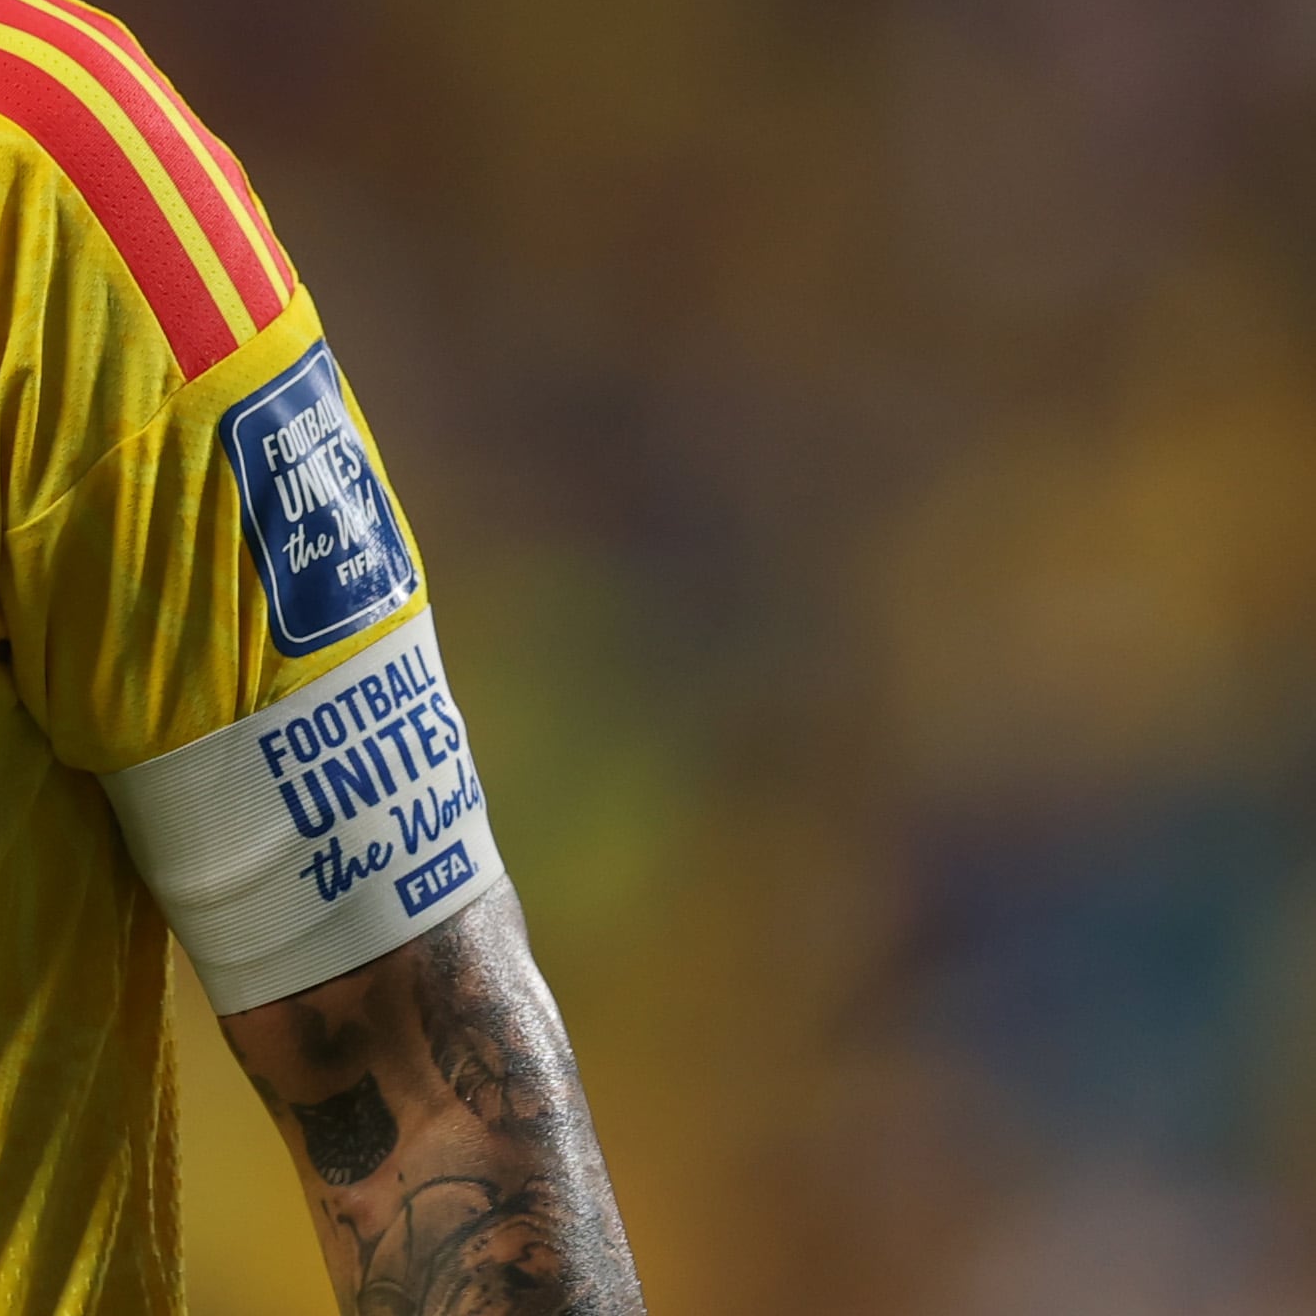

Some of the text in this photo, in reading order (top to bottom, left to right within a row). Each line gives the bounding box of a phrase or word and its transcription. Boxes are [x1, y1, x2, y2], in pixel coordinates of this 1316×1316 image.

[262, 391, 343, 472] FOOTBALL
[274, 429, 362, 523] UNITES
[282, 479, 382, 574] the Wld
[336, 548, 378, 586] FIFA
[258, 645, 436, 778] FOOTBALL
[279, 691, 461, 840] UNITES
[300, 754, 483, 902] the World
[405, 851, 469, 906] FIFA
